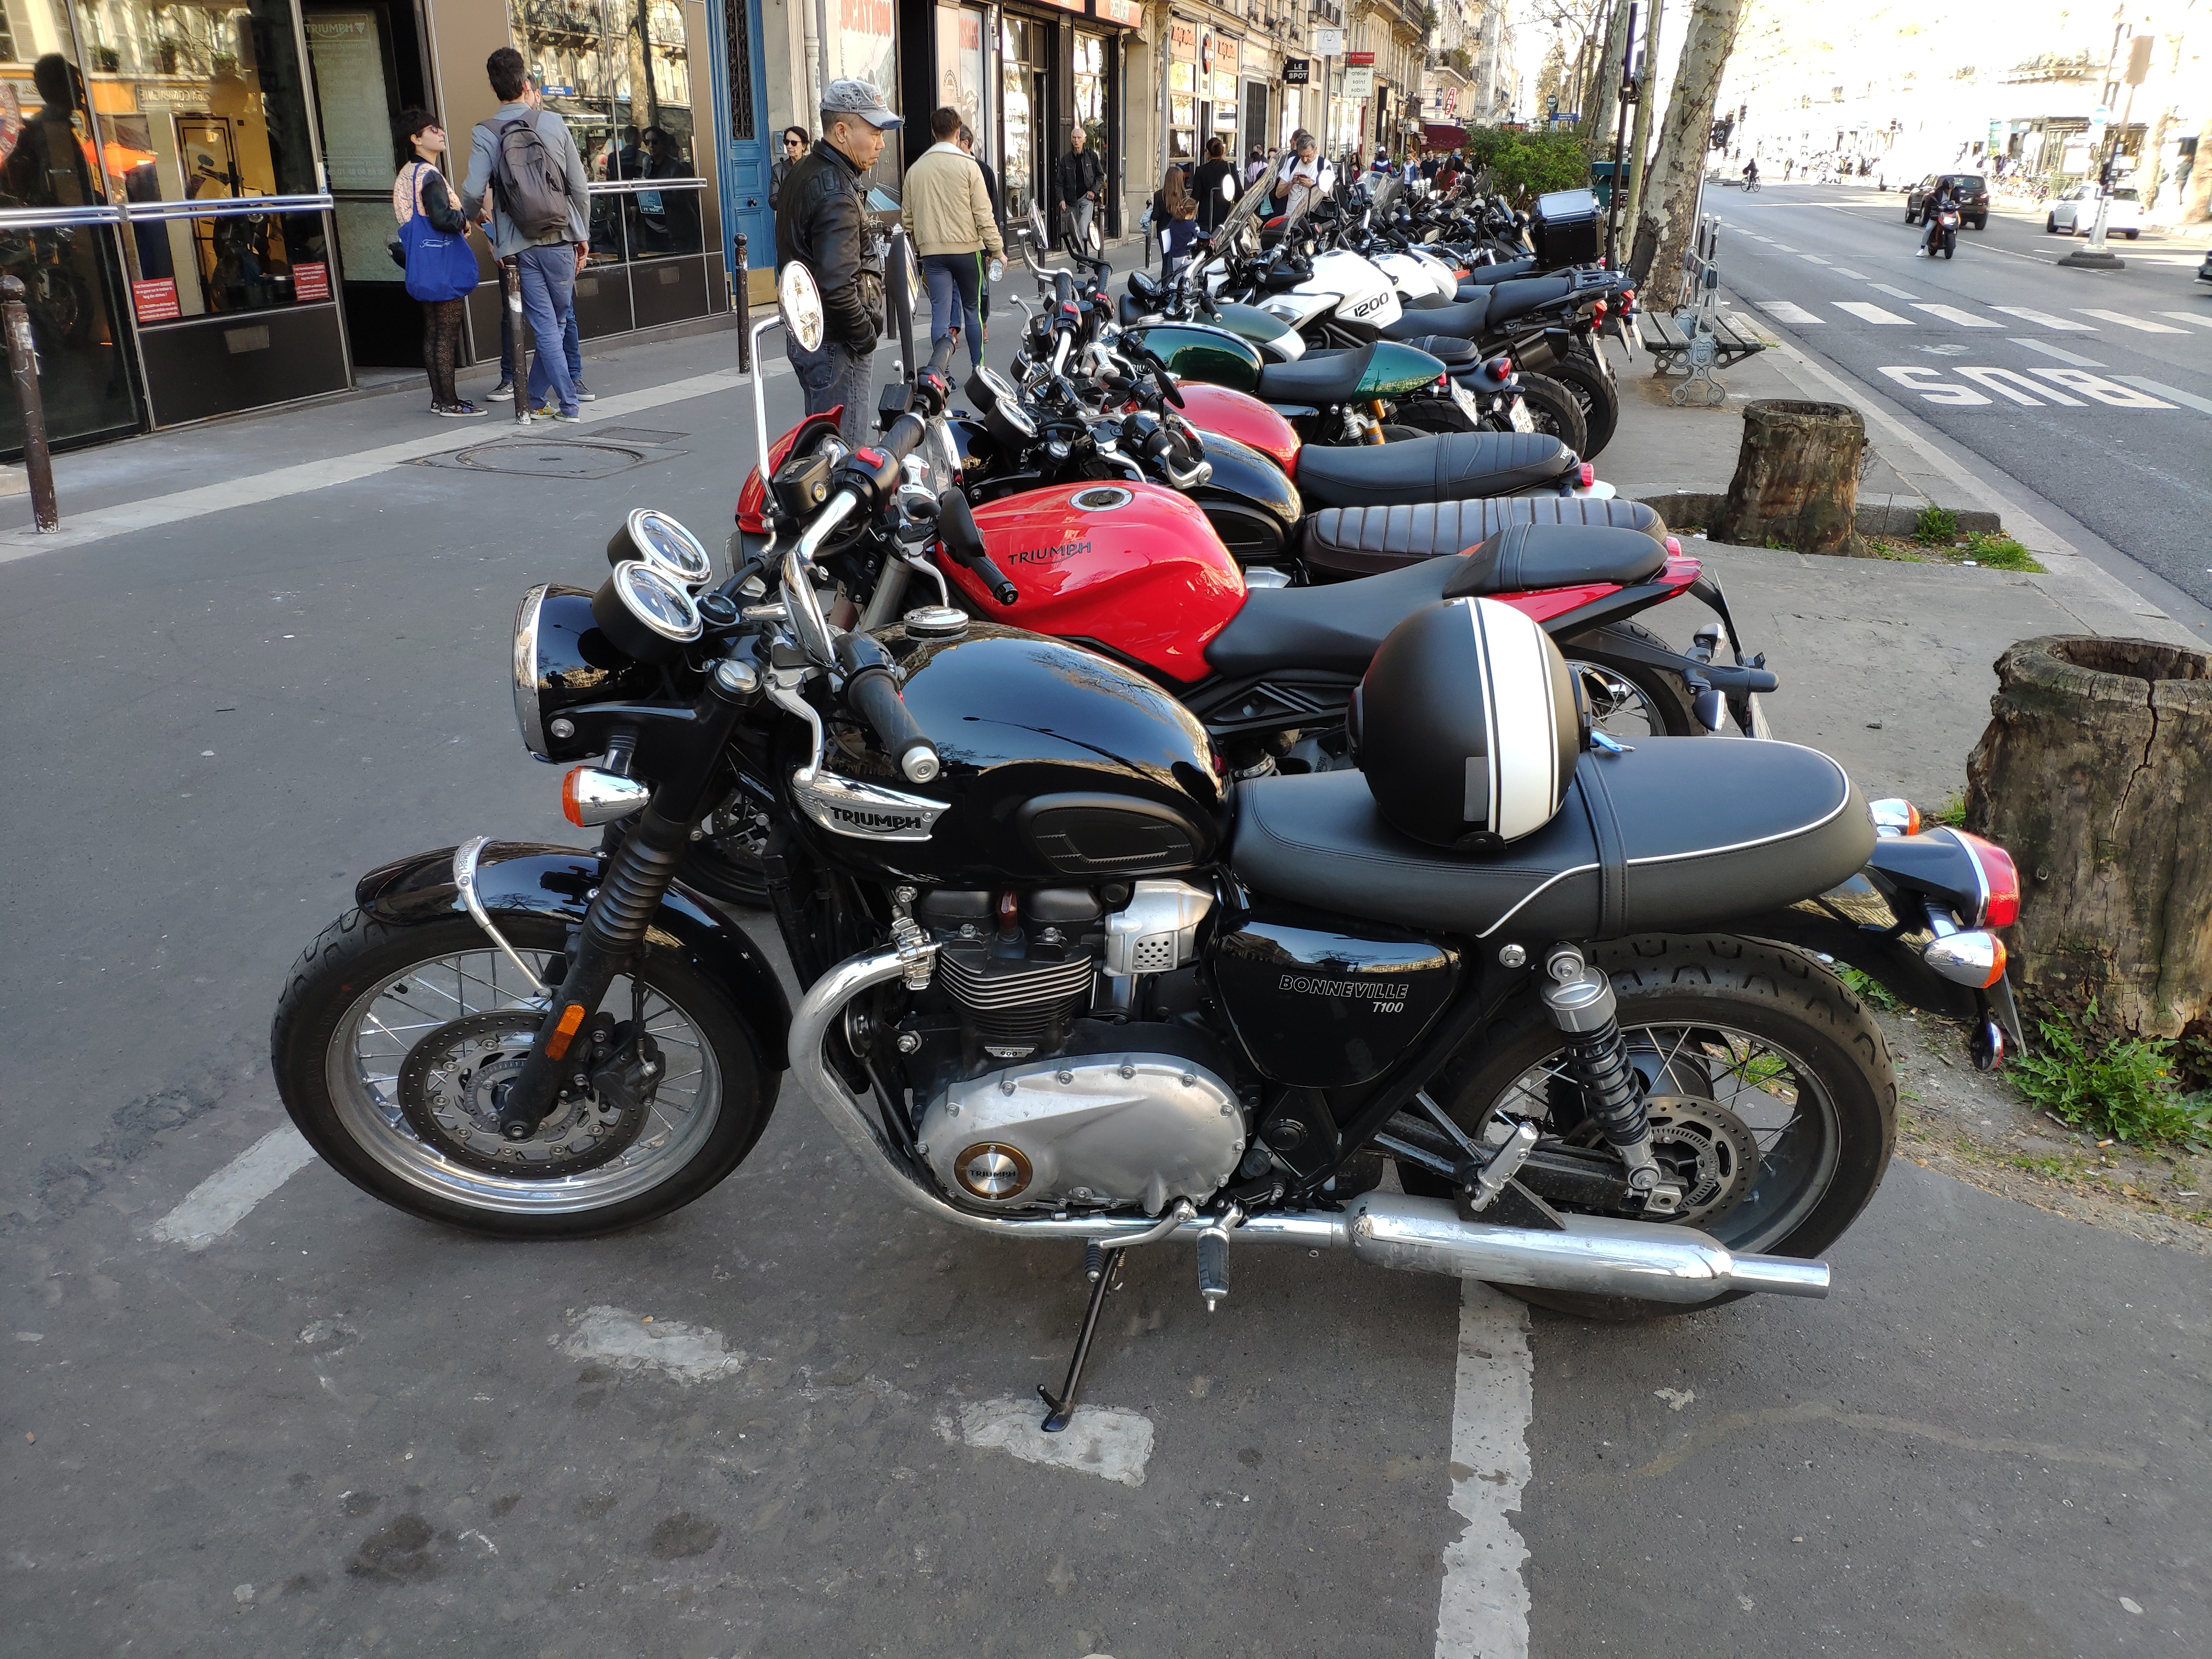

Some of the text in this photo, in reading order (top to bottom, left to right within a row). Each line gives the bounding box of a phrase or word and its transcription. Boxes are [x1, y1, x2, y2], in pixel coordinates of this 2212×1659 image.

[304, 23, 353, 37] TRIUMPH
[1445, 89, 1455, 115] TABAC
[1354, 292, 1389, 317] 1200
[1876, 366, 2181, 409] BUS
[1008, 541, 1091, 565] TRIUMPH
[830, 806, 922, 833] TRIUMPH
[459, 843, 474, 871] TRIUMPH
[1279, 975, 1409, 998] BONNEVILLE
[1373, 1002, 1404, 1013] T100
[970, 1170, 1016, 1180] TRIUMPH
